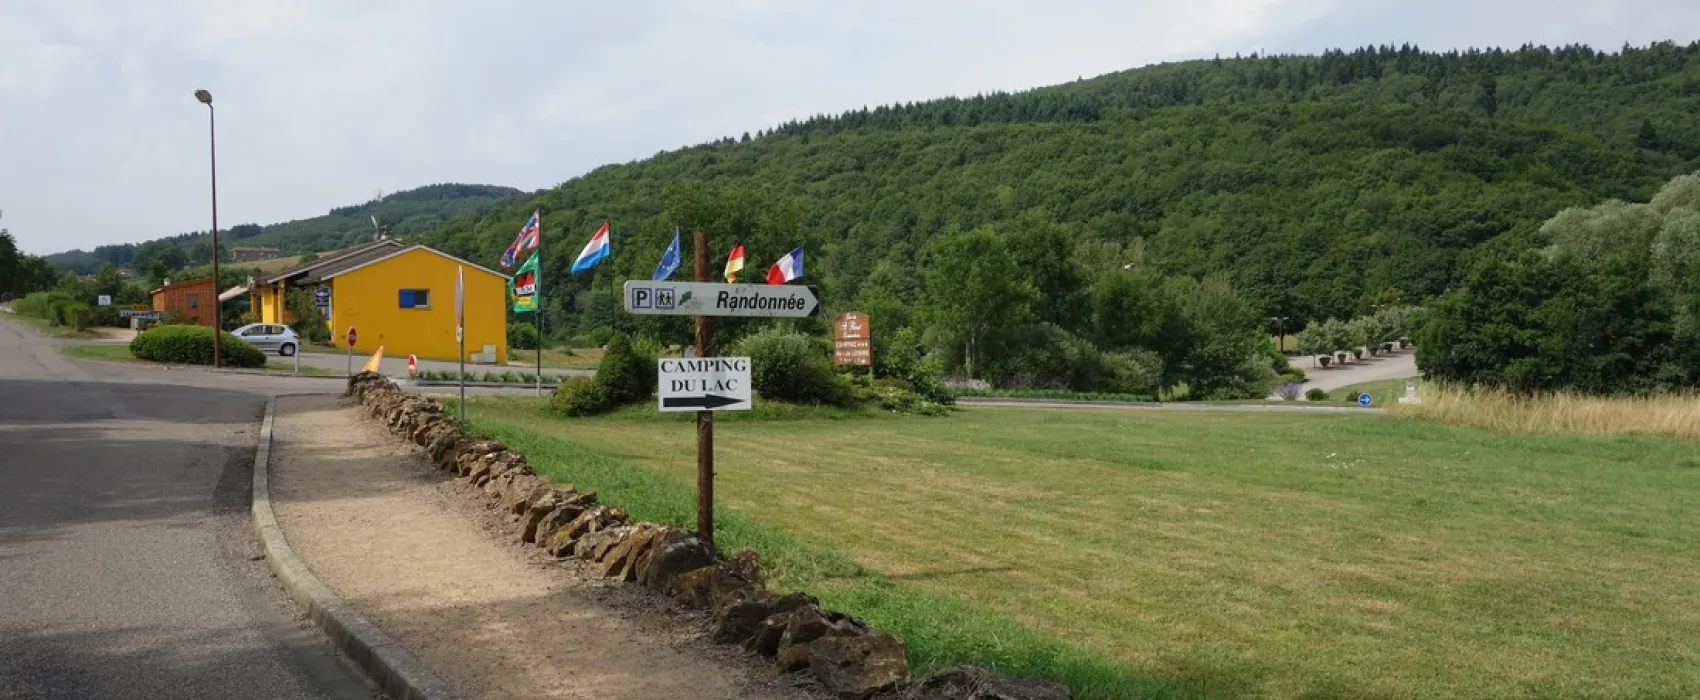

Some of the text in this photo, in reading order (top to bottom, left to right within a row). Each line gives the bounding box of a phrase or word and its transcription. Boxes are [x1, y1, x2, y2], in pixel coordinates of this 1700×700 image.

[636, 290, 647, 306] P
[716, 290, 806, 310] Randonnée
[661, 360, 746, 373] CAMPING
[671, 379, 738, 392] DU LAC
